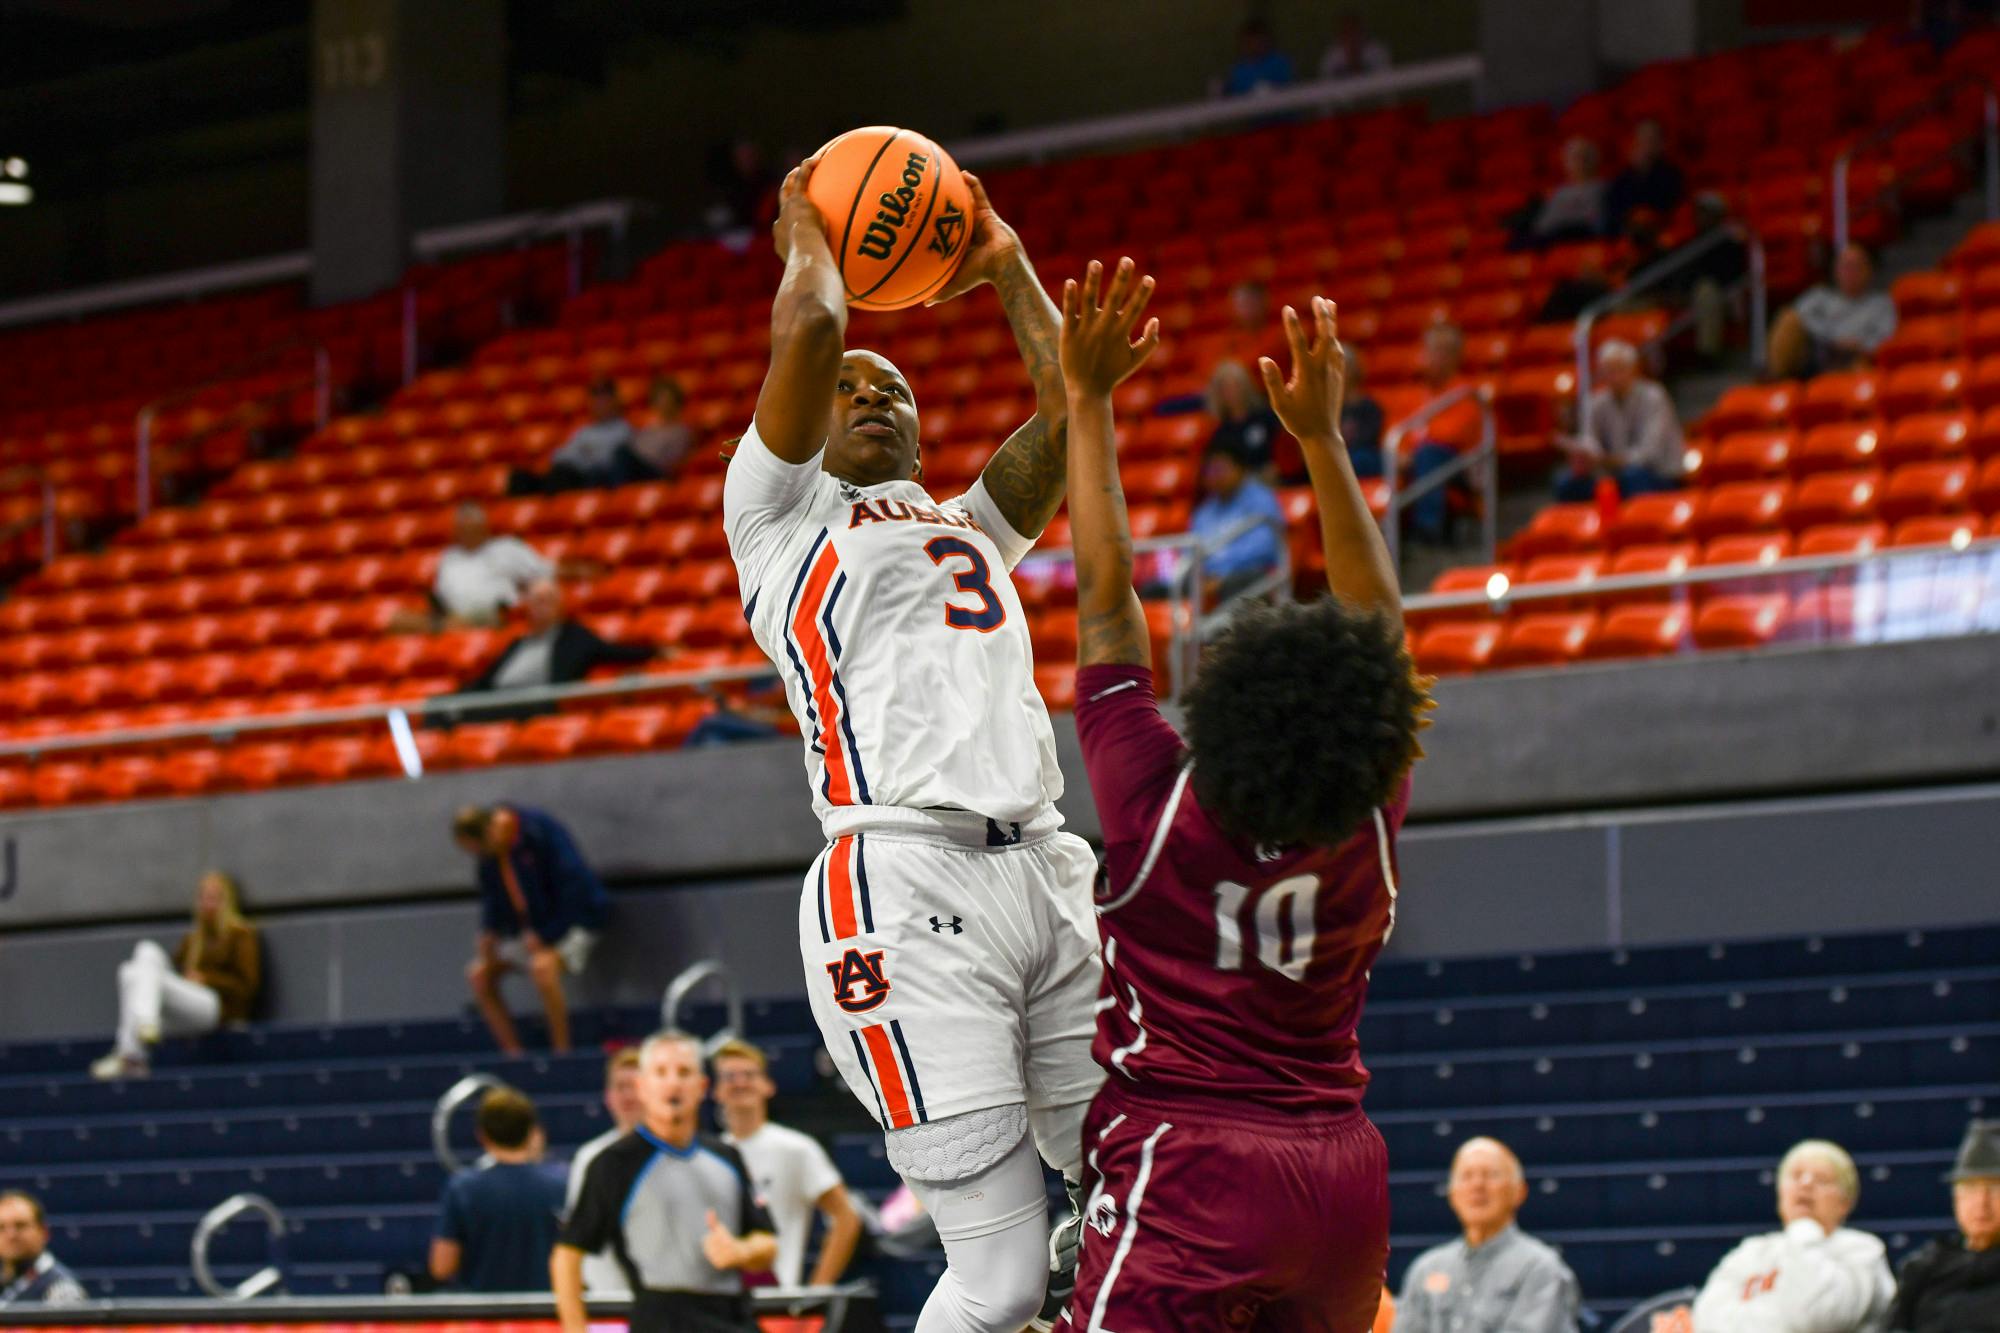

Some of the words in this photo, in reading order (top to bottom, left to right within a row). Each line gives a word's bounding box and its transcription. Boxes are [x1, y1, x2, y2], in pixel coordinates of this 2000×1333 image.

[858, 152, 929, 260] Wilson
[923, 536, 1006, 633] 3
[1214, 873, 1320, 982] 10
[826, 948, 891, 1014] AU
